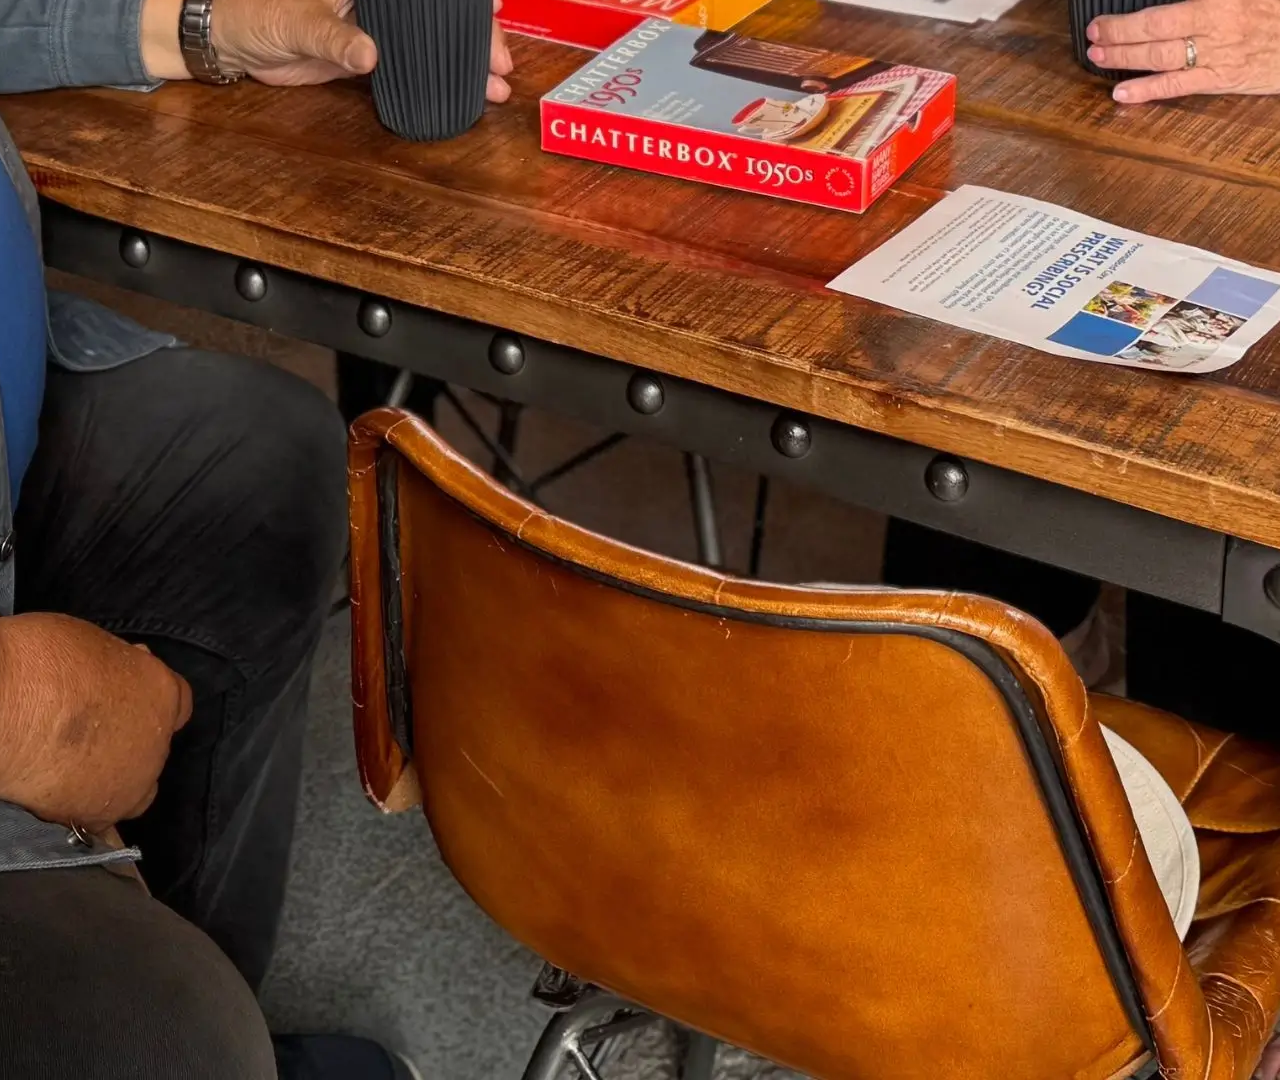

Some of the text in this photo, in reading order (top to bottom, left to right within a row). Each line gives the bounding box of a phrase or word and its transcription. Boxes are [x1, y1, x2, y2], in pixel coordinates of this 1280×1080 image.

[579, 67, 644, 108] 1950s
[744, 156, 814, 187] 1950s
[1021, 231, 1109, 297] PRESCRIBING?
[1030, 237, 1129, 310] WHAT IS SOCIAL
